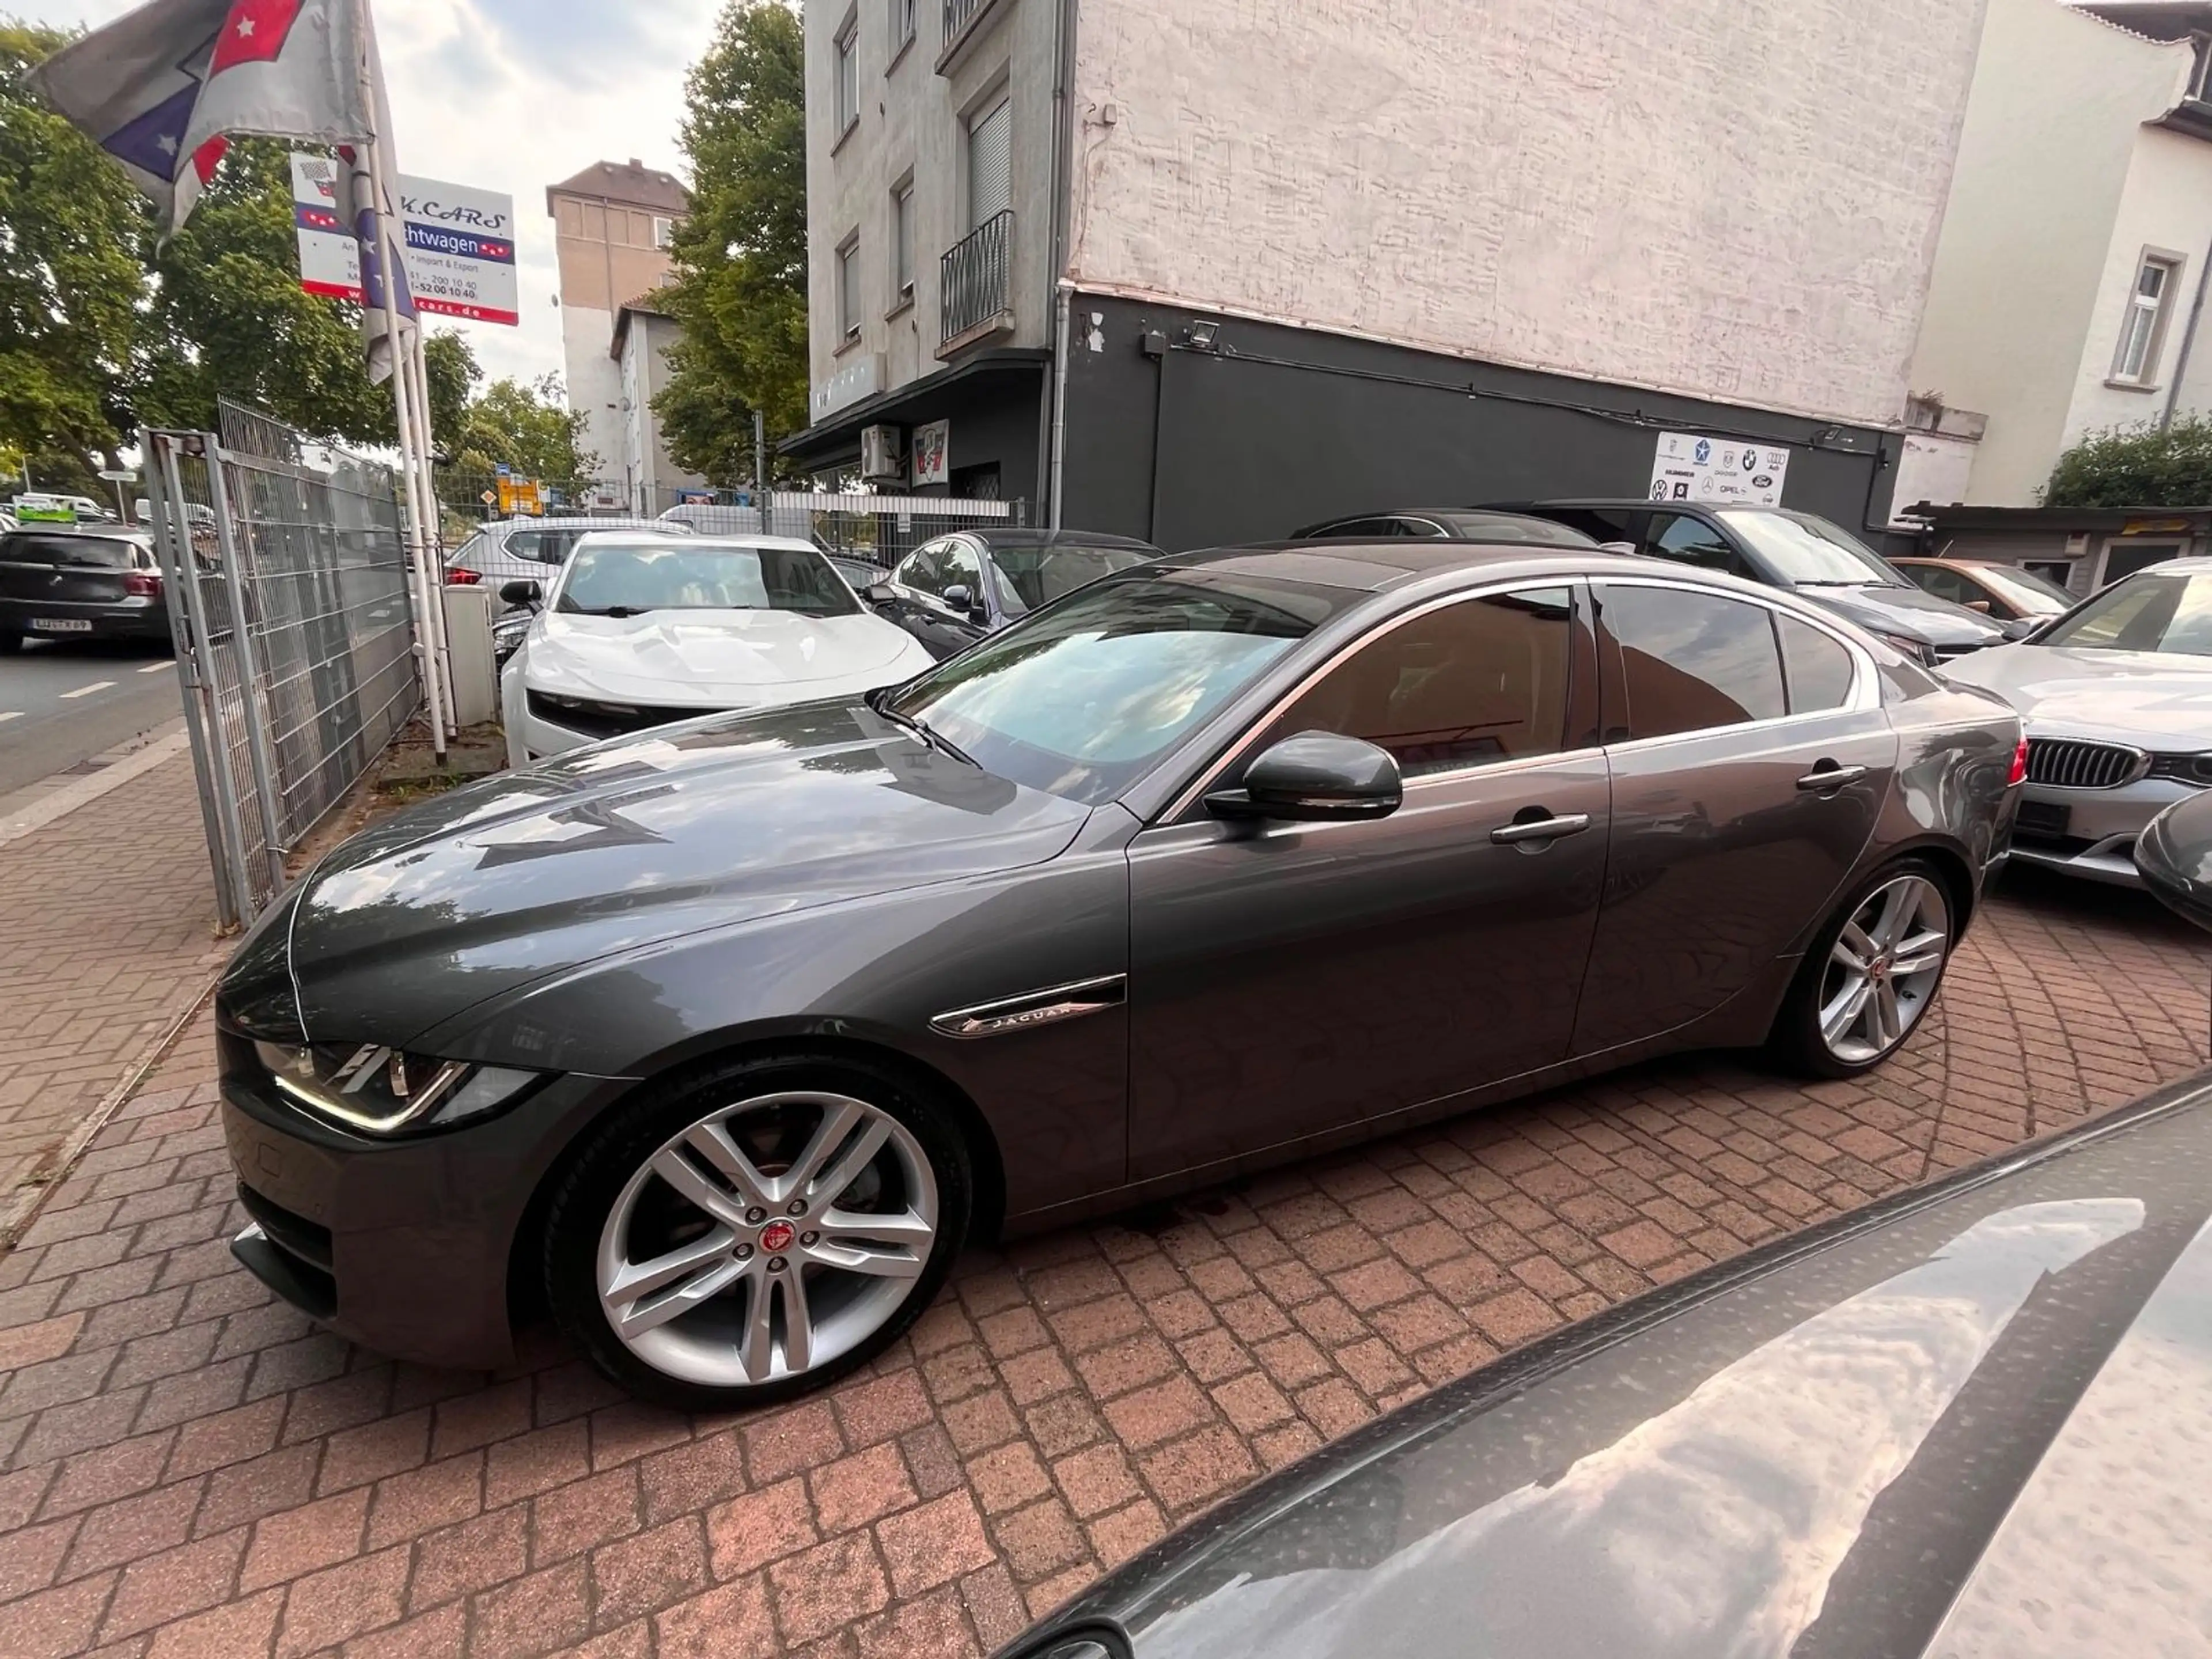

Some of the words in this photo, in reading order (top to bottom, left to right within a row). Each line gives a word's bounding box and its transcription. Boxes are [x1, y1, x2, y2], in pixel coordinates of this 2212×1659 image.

[405, 225, 478, 253] htwagen
[416, 255, 443, 267] Import
[453, 261, 479, 272] Export
[1719, 485, 1740, 494] OPEL
[993, 1007, 1071, 1029] JAGUAR
